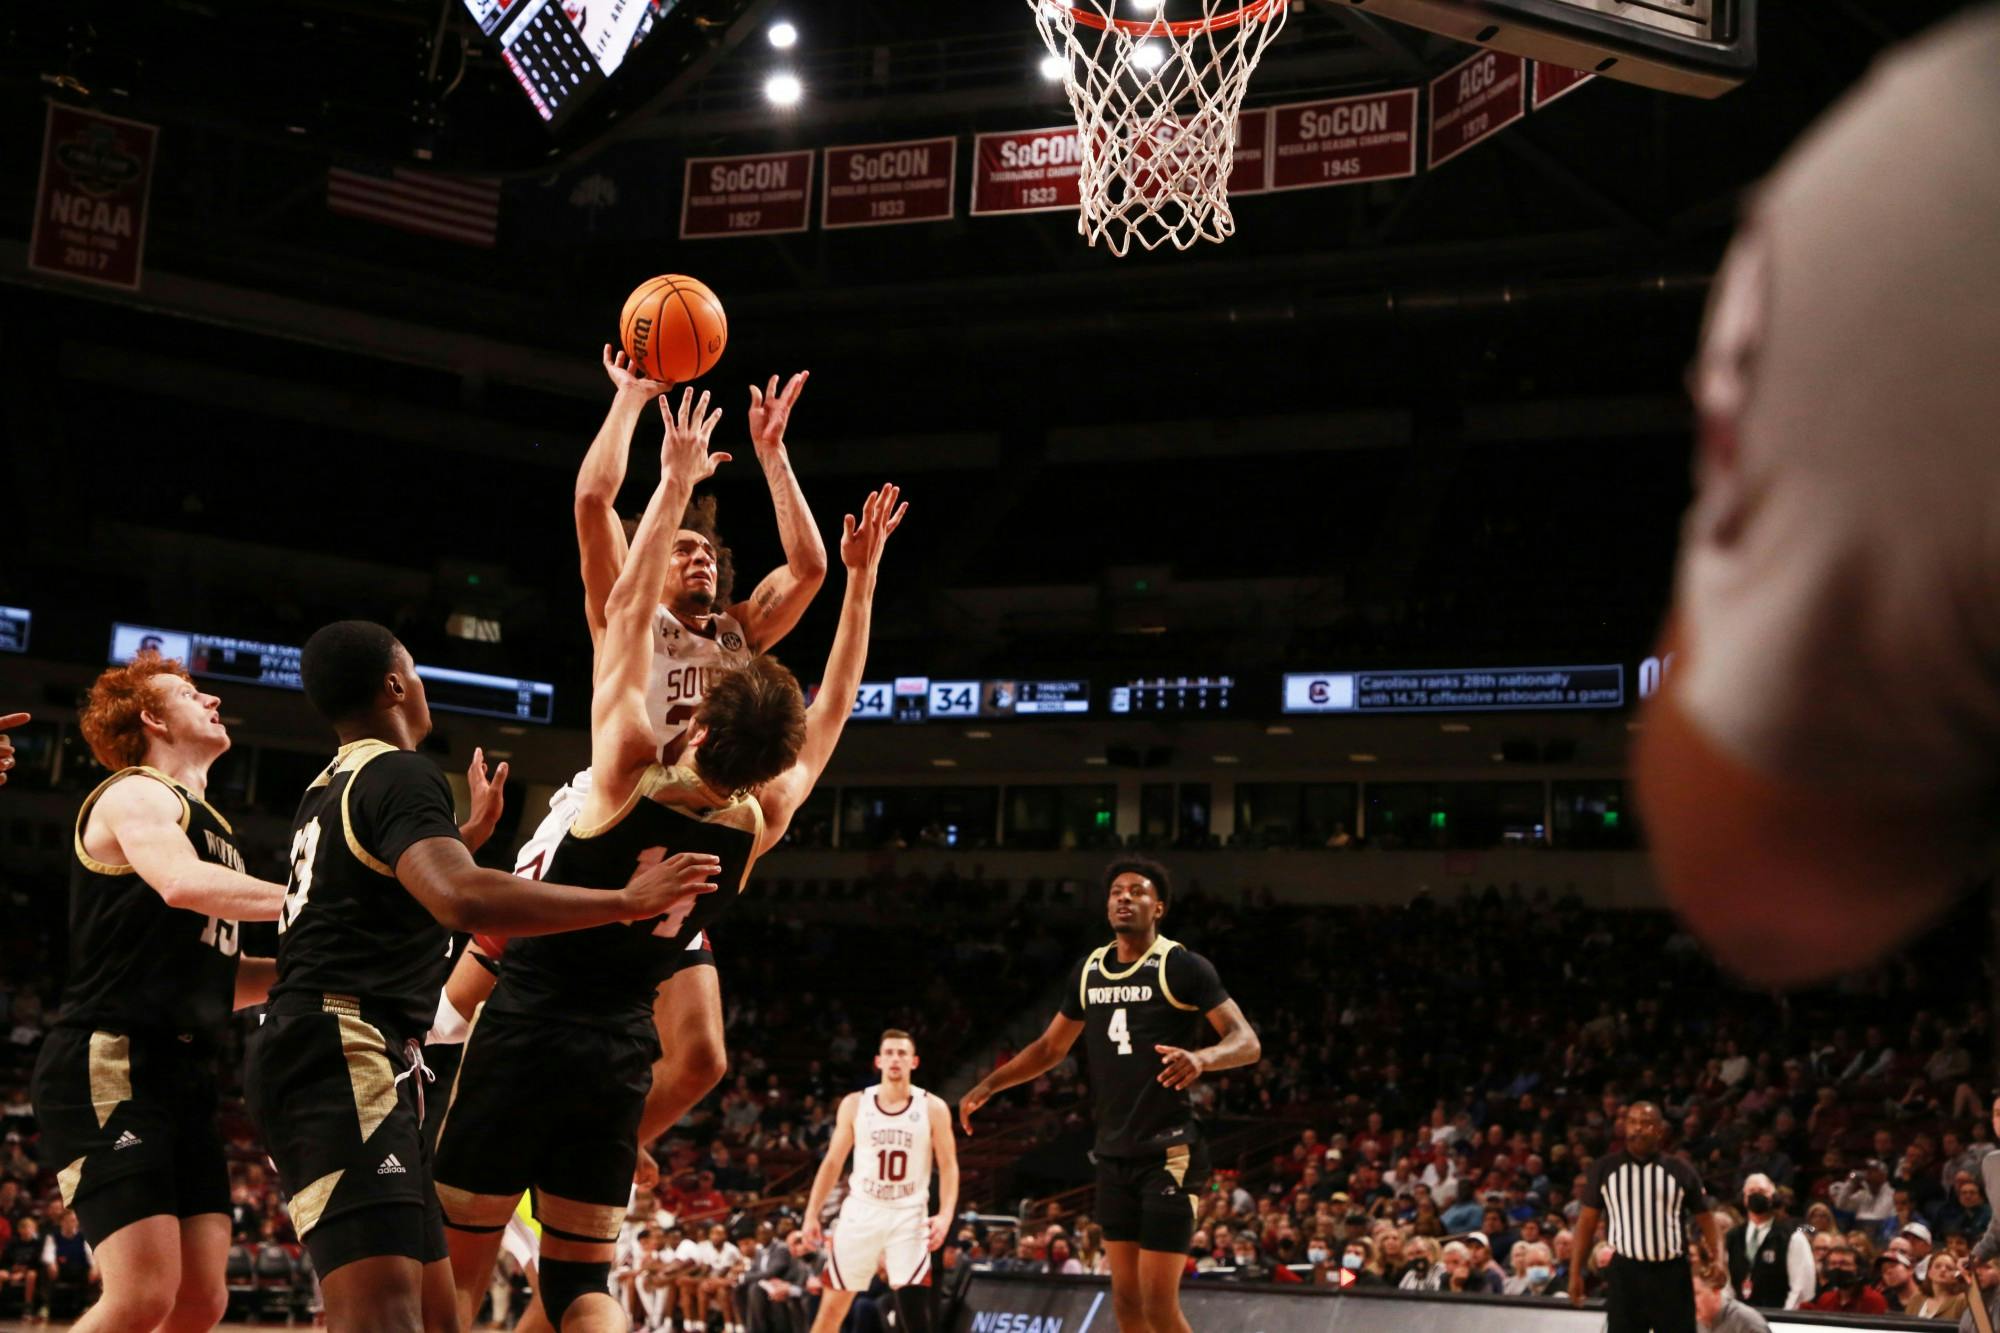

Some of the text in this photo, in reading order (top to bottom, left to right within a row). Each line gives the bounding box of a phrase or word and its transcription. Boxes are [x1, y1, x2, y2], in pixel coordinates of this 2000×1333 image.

[1458, 54, 1497, 104] ACC
[1299, 101, 1388, 140] SoCON
[710, 161, 789, 193] SoCON
[848, 148, 930, 182] SoCON
[1322, 158, 1361, 177] 1945
[50, 189, 132, 238] NCAA
[63, 247, 110, 272] 2017
[1361, 676, 1419, 690] Carolina
[1421, 674, 1459, 688] ranks
[1499, 672, 1570, 688] nationally
[936, 687, 972, 712] 34
[1360, 692, 1391, 705] with
[1430, 689, 1494, 704] offensive
[1497, 687, 1563, 703] rebounds
[1567, 689, 1577, 700] a
[1579, 689, 1618, 704] game
[1088, 986, 1152, 1004] WOFFORD
[1107, 1008, 1132, 1055] 4
[871, 1128, 913, 1149] SOUTH
[377, 1166, 407, 1175] adidas
[877, 1149, 908, 1182] 10
[971, 1311, 1063, 1333] NISSAN
